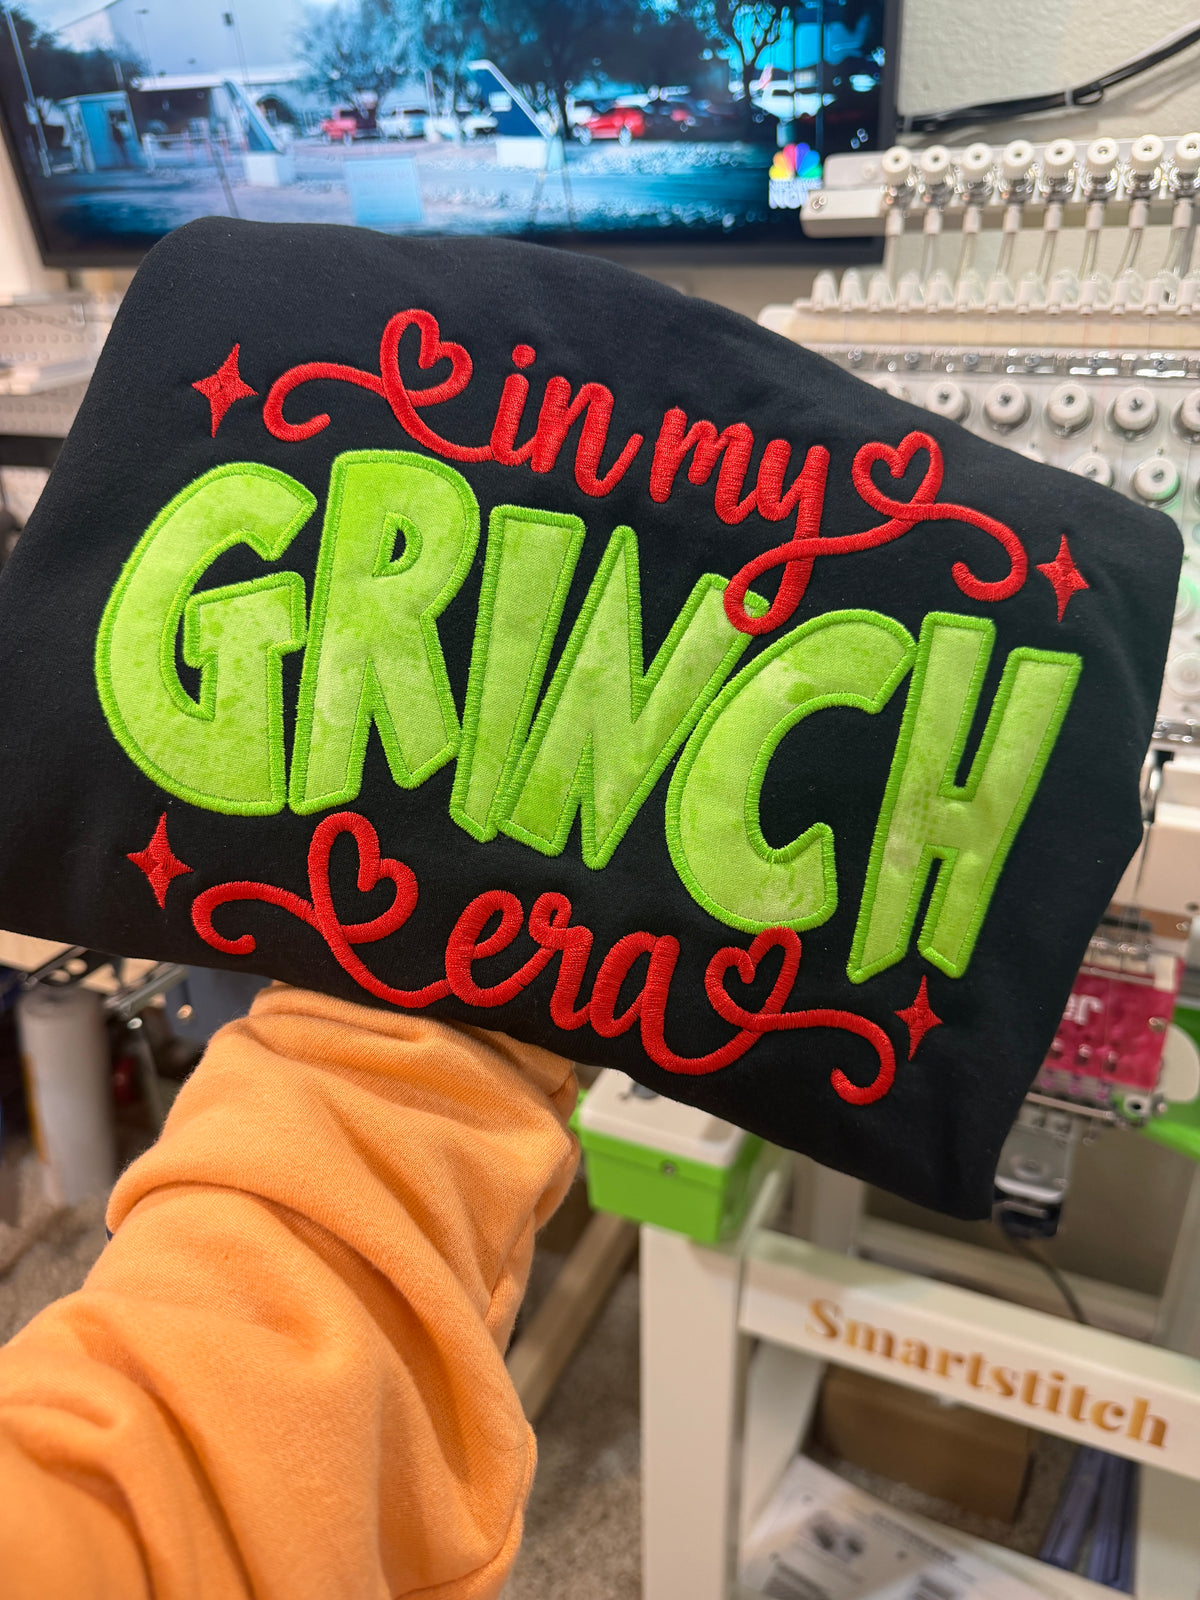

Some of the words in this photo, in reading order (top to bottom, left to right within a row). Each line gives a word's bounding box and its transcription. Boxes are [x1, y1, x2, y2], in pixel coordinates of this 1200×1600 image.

[489, 344, 644, 498] in
[649, 406, 831, 636] my
[93, 448, 1083, 984] GRINCH
[444, 889, 684, 1075] era
[805, 1298, 1169, 1449] Smartstitch
